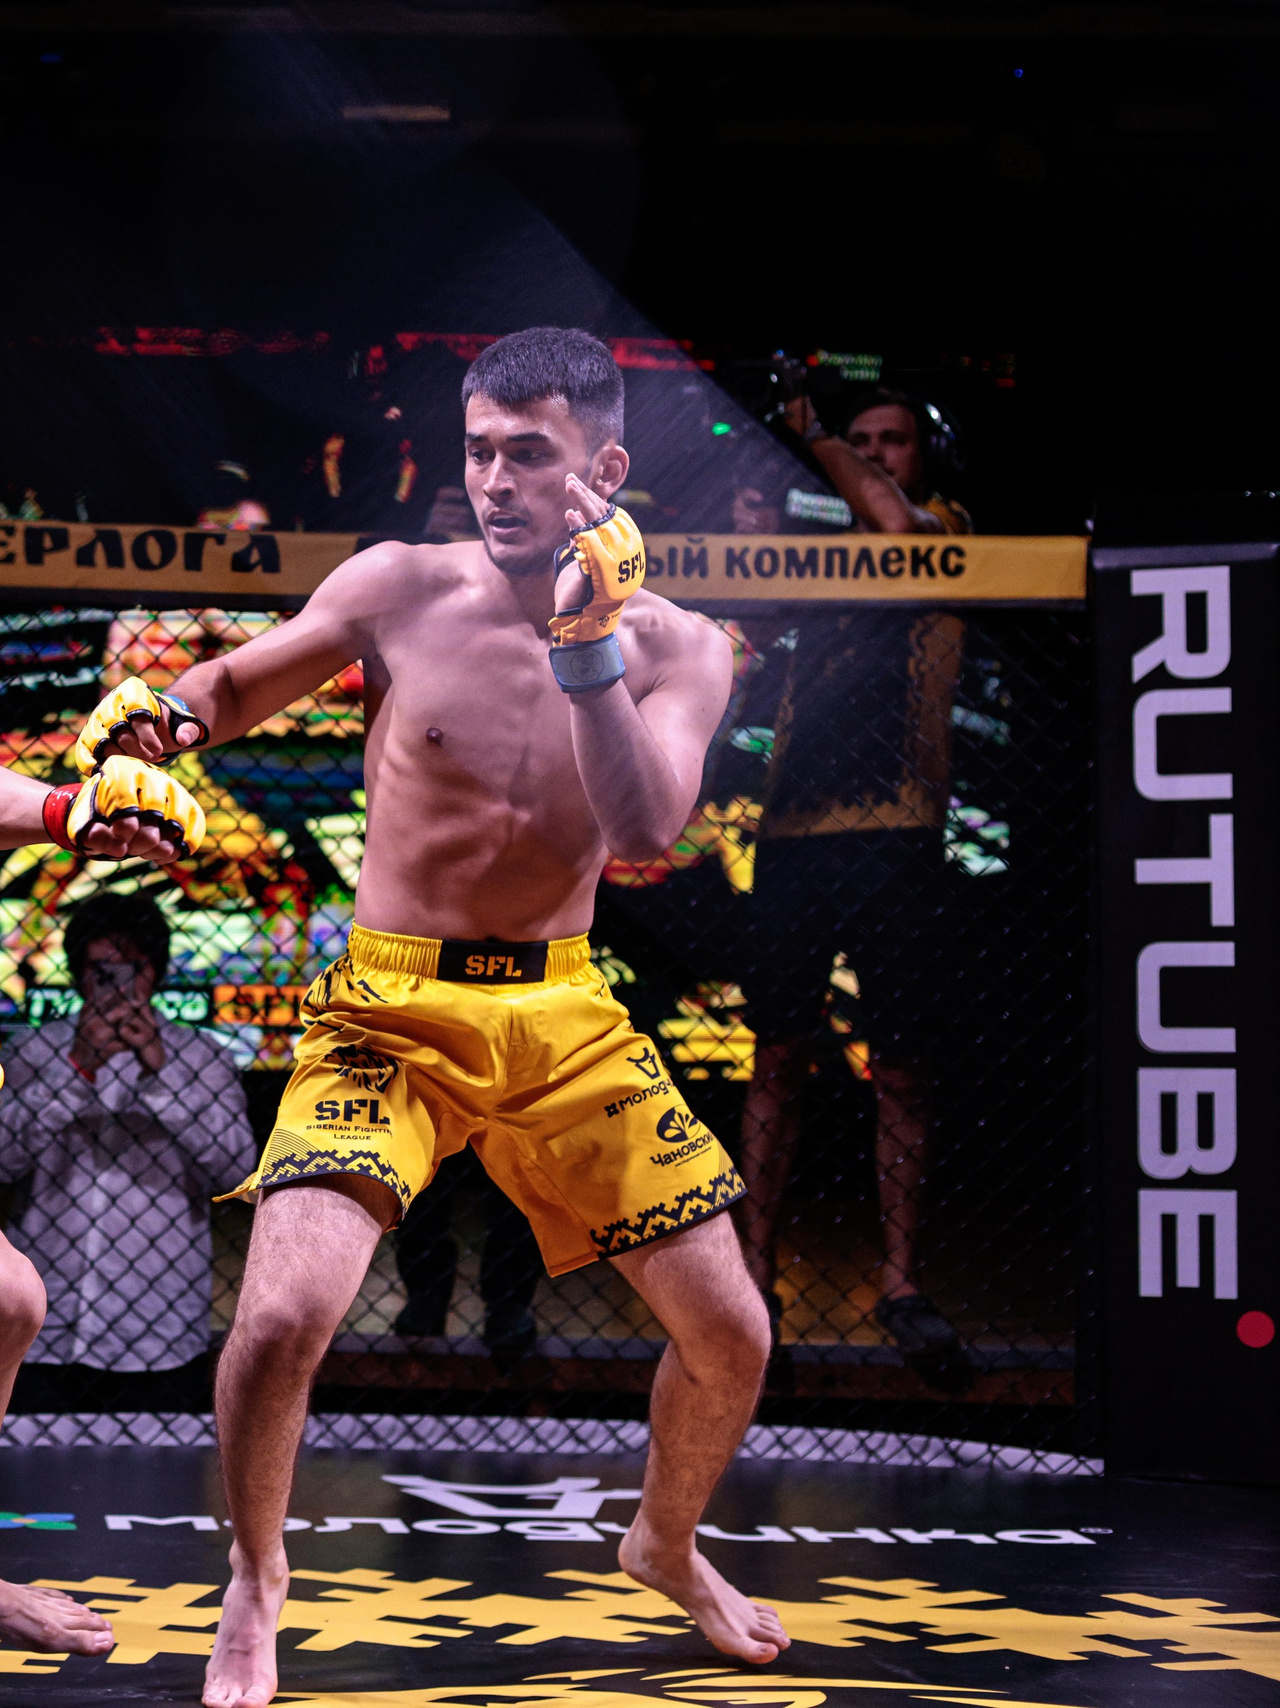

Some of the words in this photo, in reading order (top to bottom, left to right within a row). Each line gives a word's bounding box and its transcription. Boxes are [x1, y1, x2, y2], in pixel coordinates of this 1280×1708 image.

[618, 551, 645, 584] SFL
[1130, 565, 1239, 1300] RUTUBE
[465, 954, 523, 978] SFL
[315, 1098, 391, 1126] SFL
